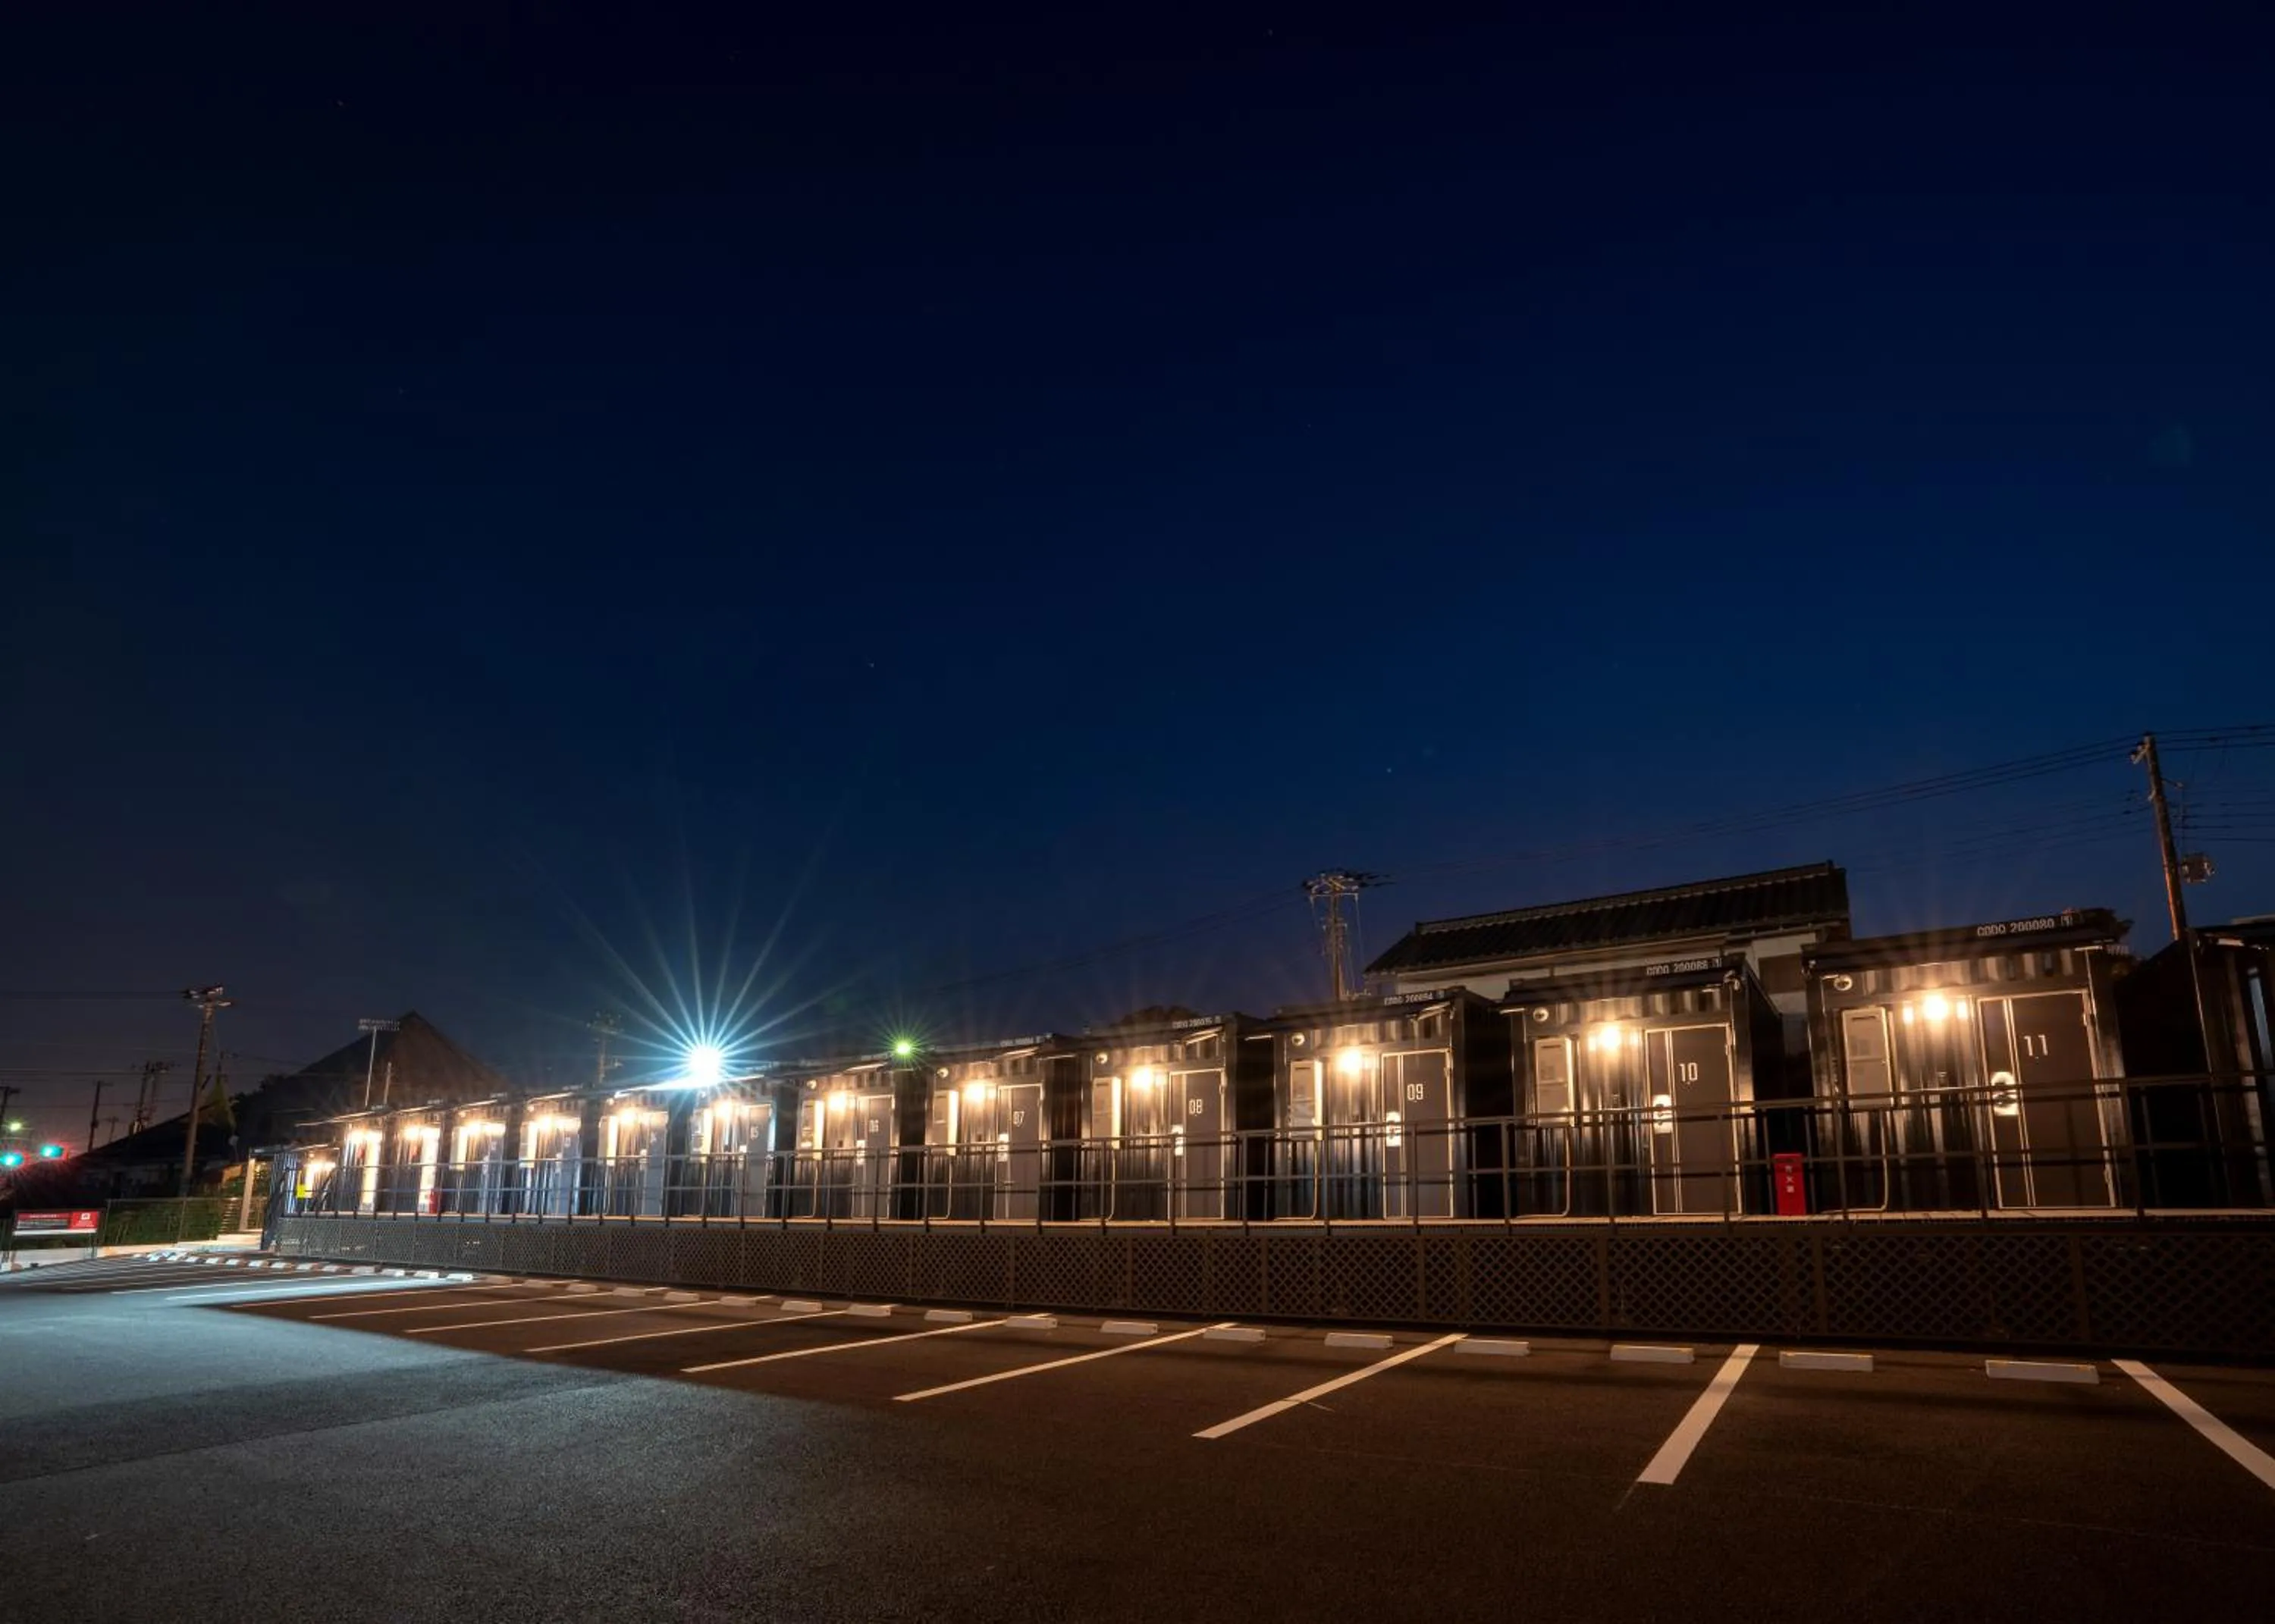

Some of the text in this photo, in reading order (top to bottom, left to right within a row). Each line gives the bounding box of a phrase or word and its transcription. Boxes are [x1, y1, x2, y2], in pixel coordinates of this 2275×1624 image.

[2023, 1035, 2048, 1056] 11
[1679, 1062, 1698, 1082] 10
[1407, 1083, 1423, 1100] 09
[1188, 1099, 1203, 1114] 08
